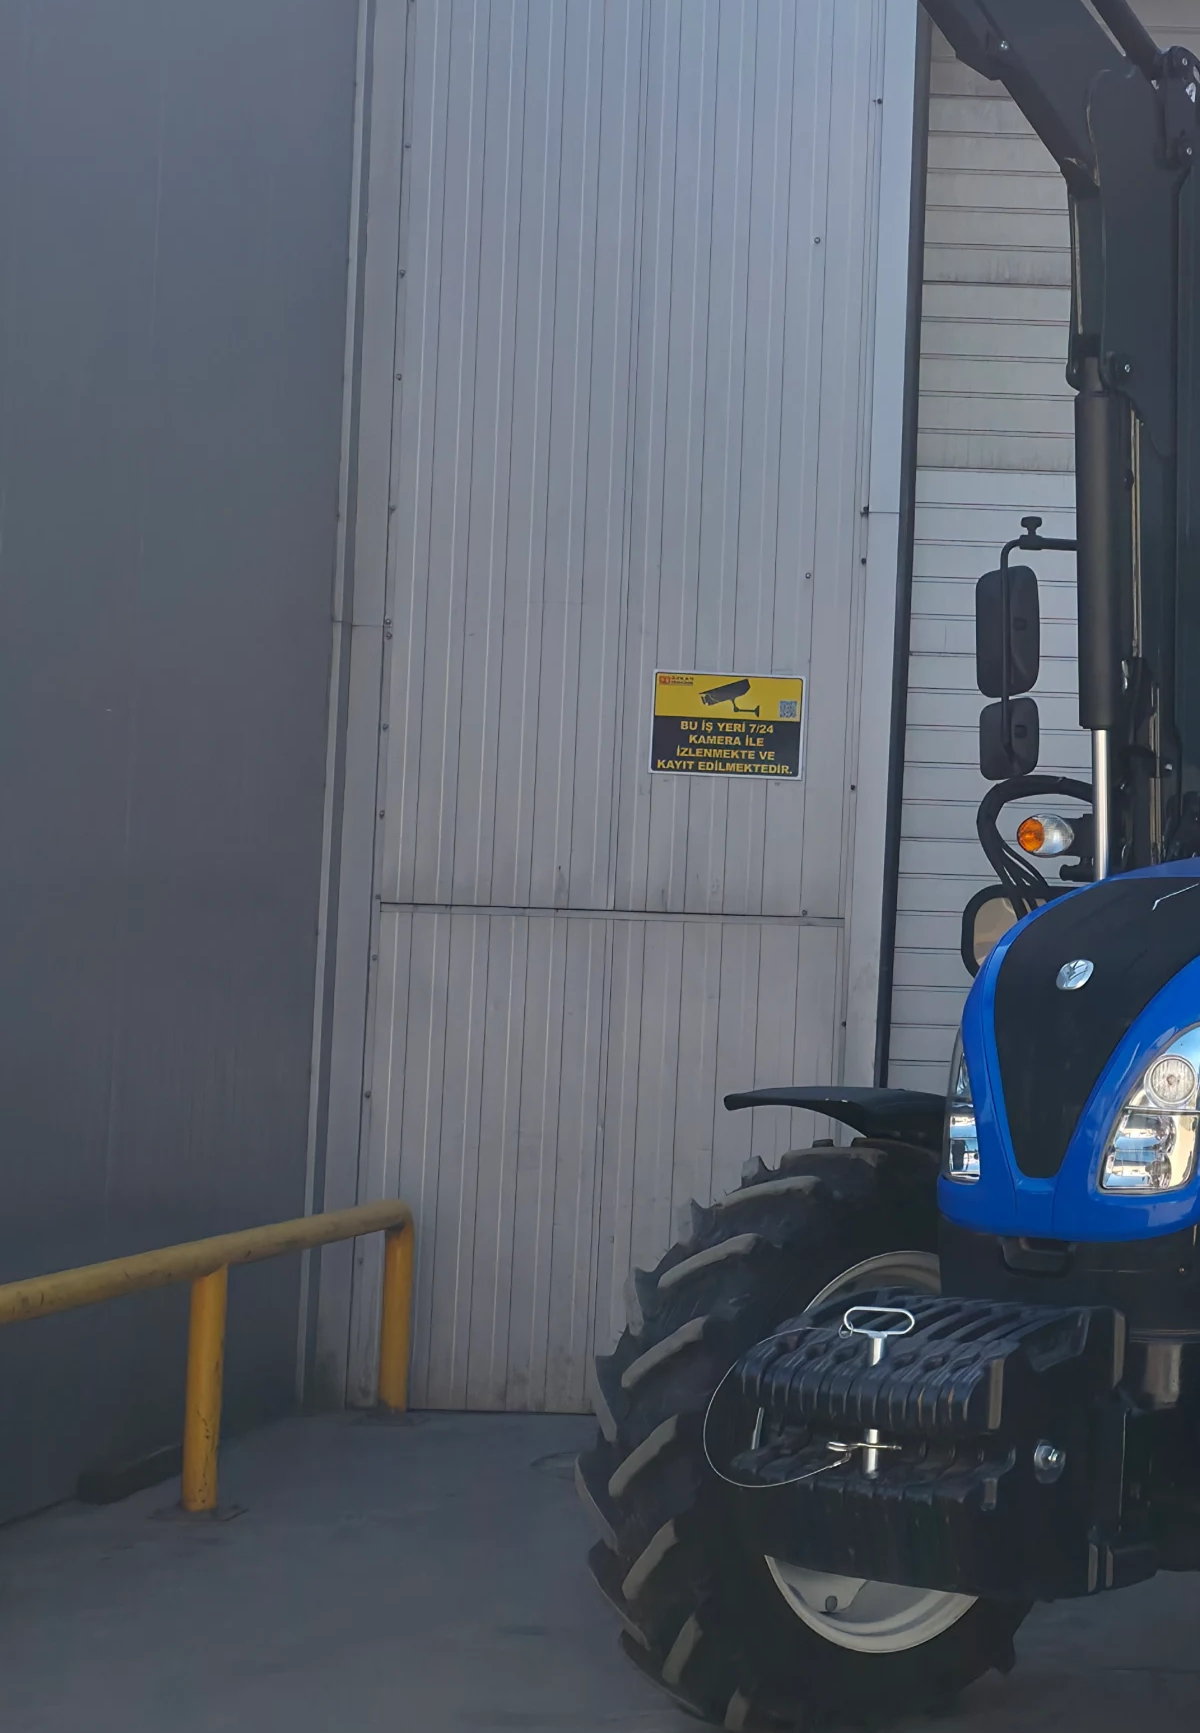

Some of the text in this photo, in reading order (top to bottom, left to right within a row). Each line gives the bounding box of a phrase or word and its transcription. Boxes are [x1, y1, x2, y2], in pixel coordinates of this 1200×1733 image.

[680, 720, 774, 734] BU İŞ YERİ 7/24
[689, 734, 765, 747] KAMERA İLE
[676, 745, 776, 760] İZLENMEKTE VE
[657, 759, 793, 775] KAYIT EDİLMEKTEDİR.
